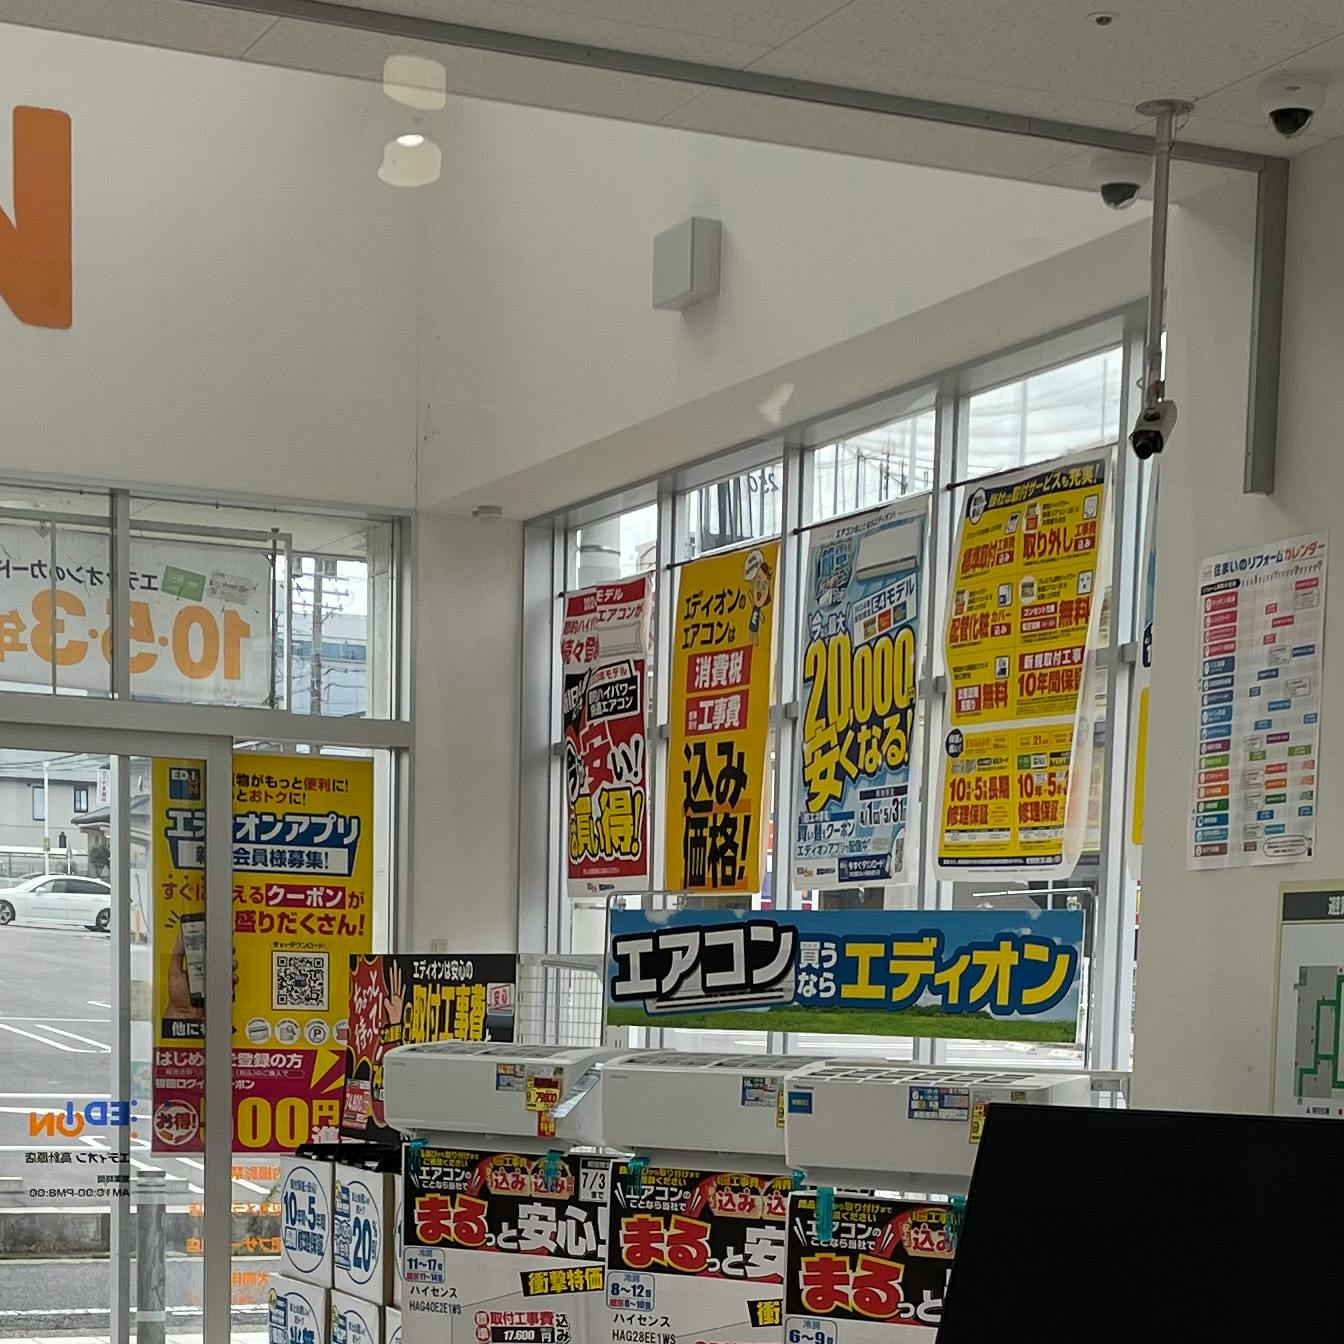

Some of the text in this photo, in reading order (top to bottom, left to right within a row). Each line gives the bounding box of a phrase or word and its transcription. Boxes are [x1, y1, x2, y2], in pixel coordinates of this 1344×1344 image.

[681, 621, 737, 650] エアコンは
[694, 651, 743, 689] 消費税
[803, 712, 914, 813] 安くなる!
[683, 741, 748, 815] 込み
[682, 814, 750, 889] 価格!
[615, 925, 839, 1001] エアコン 買う
[841, 936, 1071, 1006] エディオン
[798, 972, 838, 999] なら
[418, 1165, 472, 1181] エアコンの
[410, 1285, 458, 1299] ハイセンス
[528, 1266, 604, 1296] 衝撃特価
[490, 1312, 555, 1328] 取付工事費
[613, 1312, 672, 1329] ハイセンス
